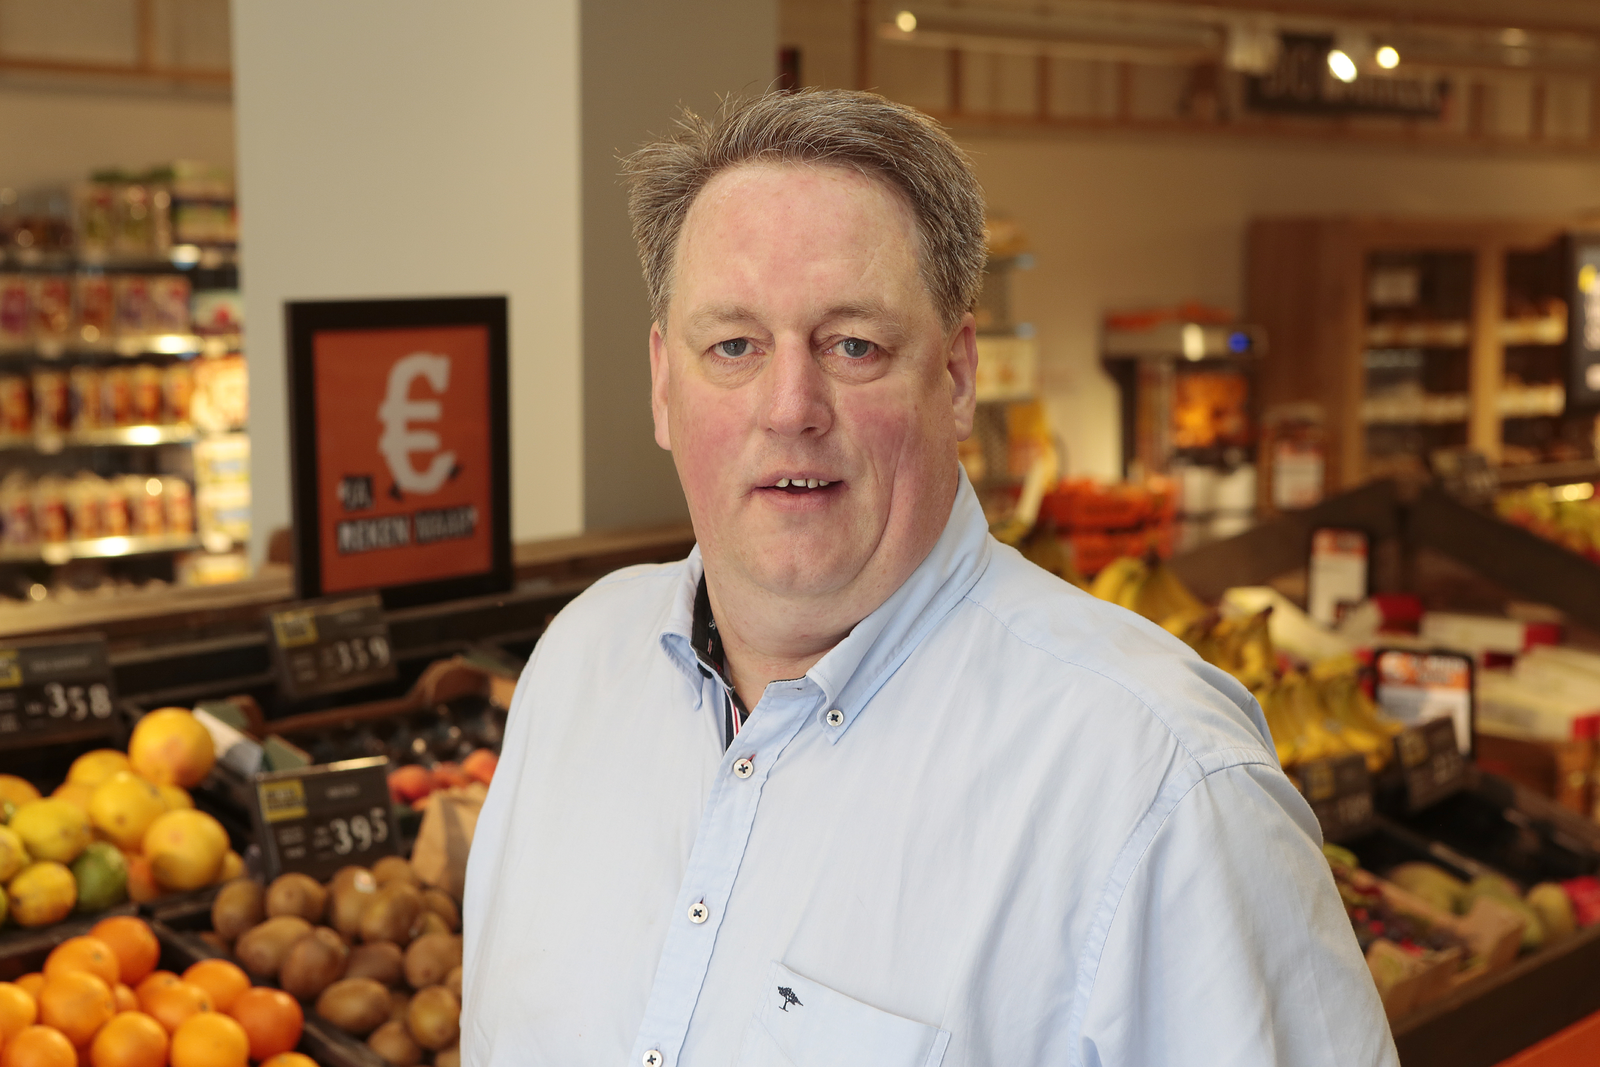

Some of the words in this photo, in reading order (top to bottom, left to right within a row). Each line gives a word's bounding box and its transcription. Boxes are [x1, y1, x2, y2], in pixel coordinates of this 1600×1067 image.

[334, 636, 391, 675] 359
[44, 682, 112, 722] 358
[330, 807, 389, 855] 395
